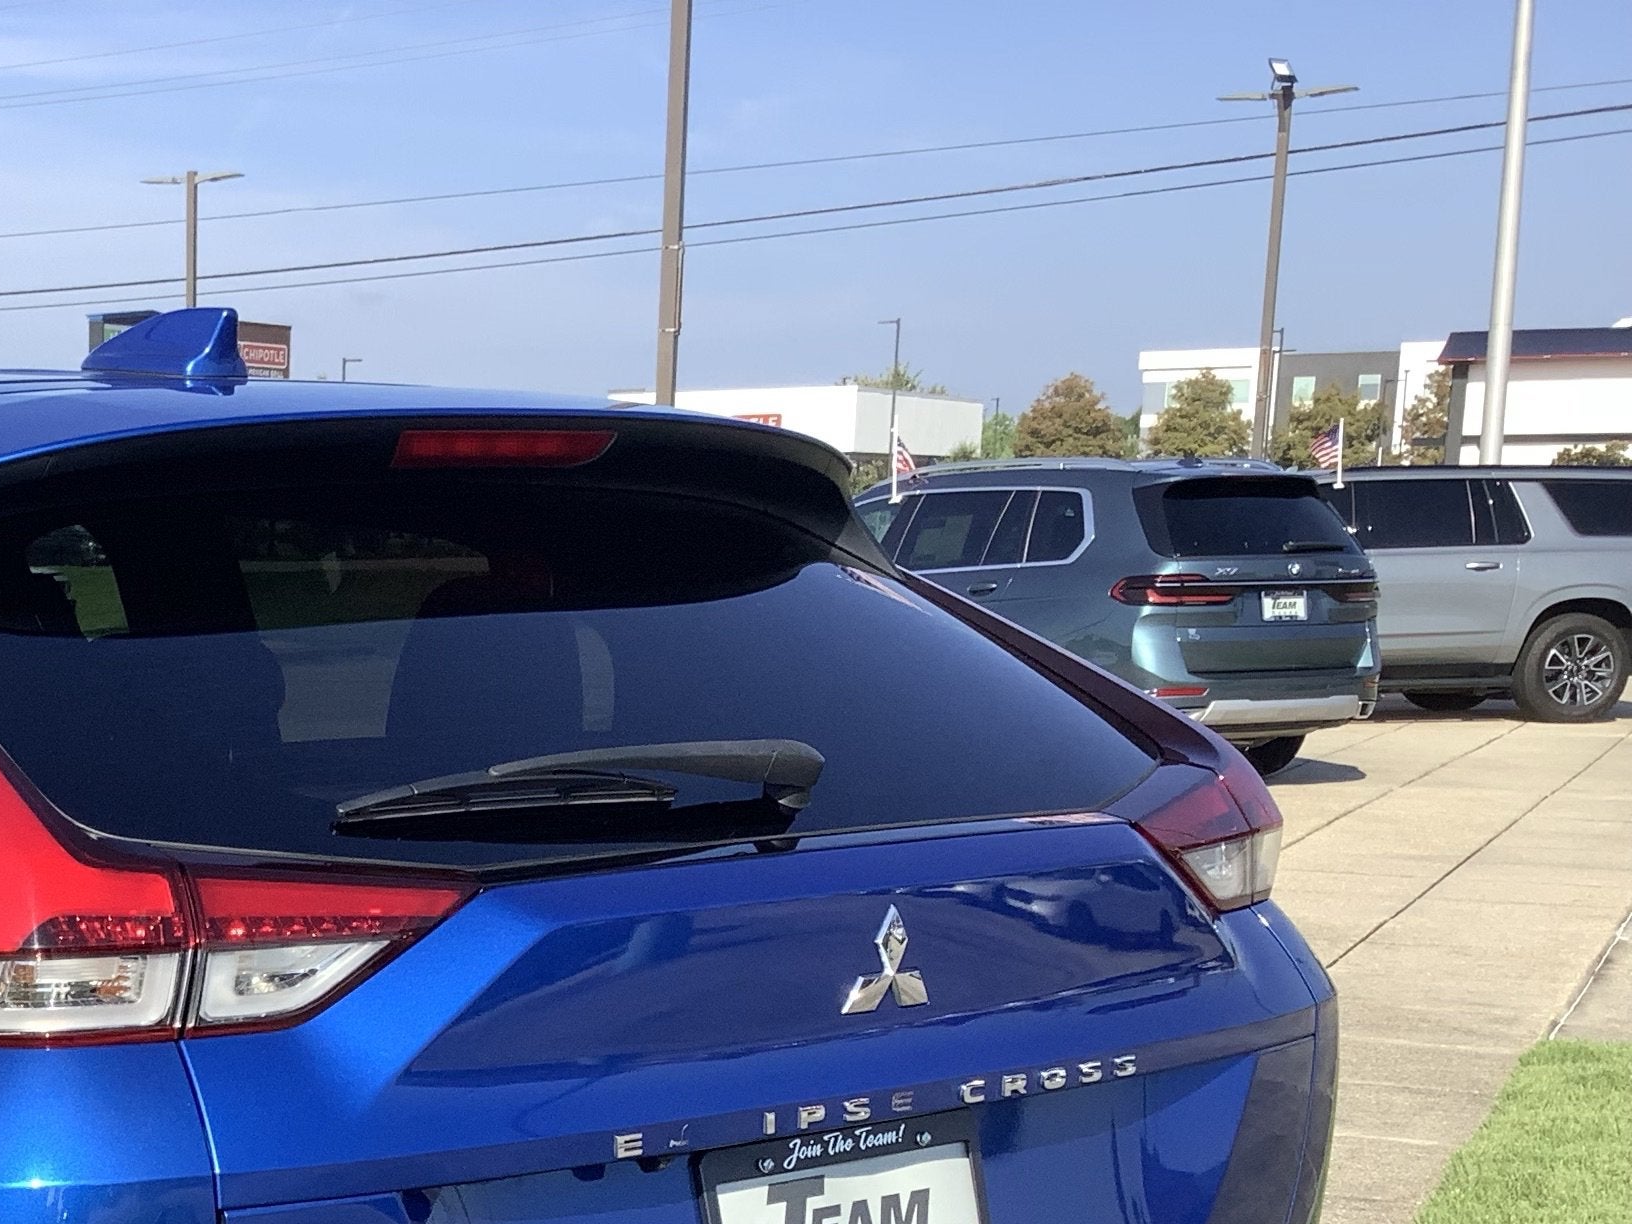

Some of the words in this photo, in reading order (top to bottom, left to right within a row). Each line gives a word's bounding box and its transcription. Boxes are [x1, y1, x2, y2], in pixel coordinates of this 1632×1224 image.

[243, 347, 285, 362] CHIPOTLE
[1271, 596, 1297, 609] TEAM
[614, 1091, 914, 1158] EIPSE
[960, 1055, 1136, 1104] CROSS
[783, 1138, 823, 1169] Join
[823, 1131, 855, 1155] The
[854, 1123, 905, 1150] Team!
